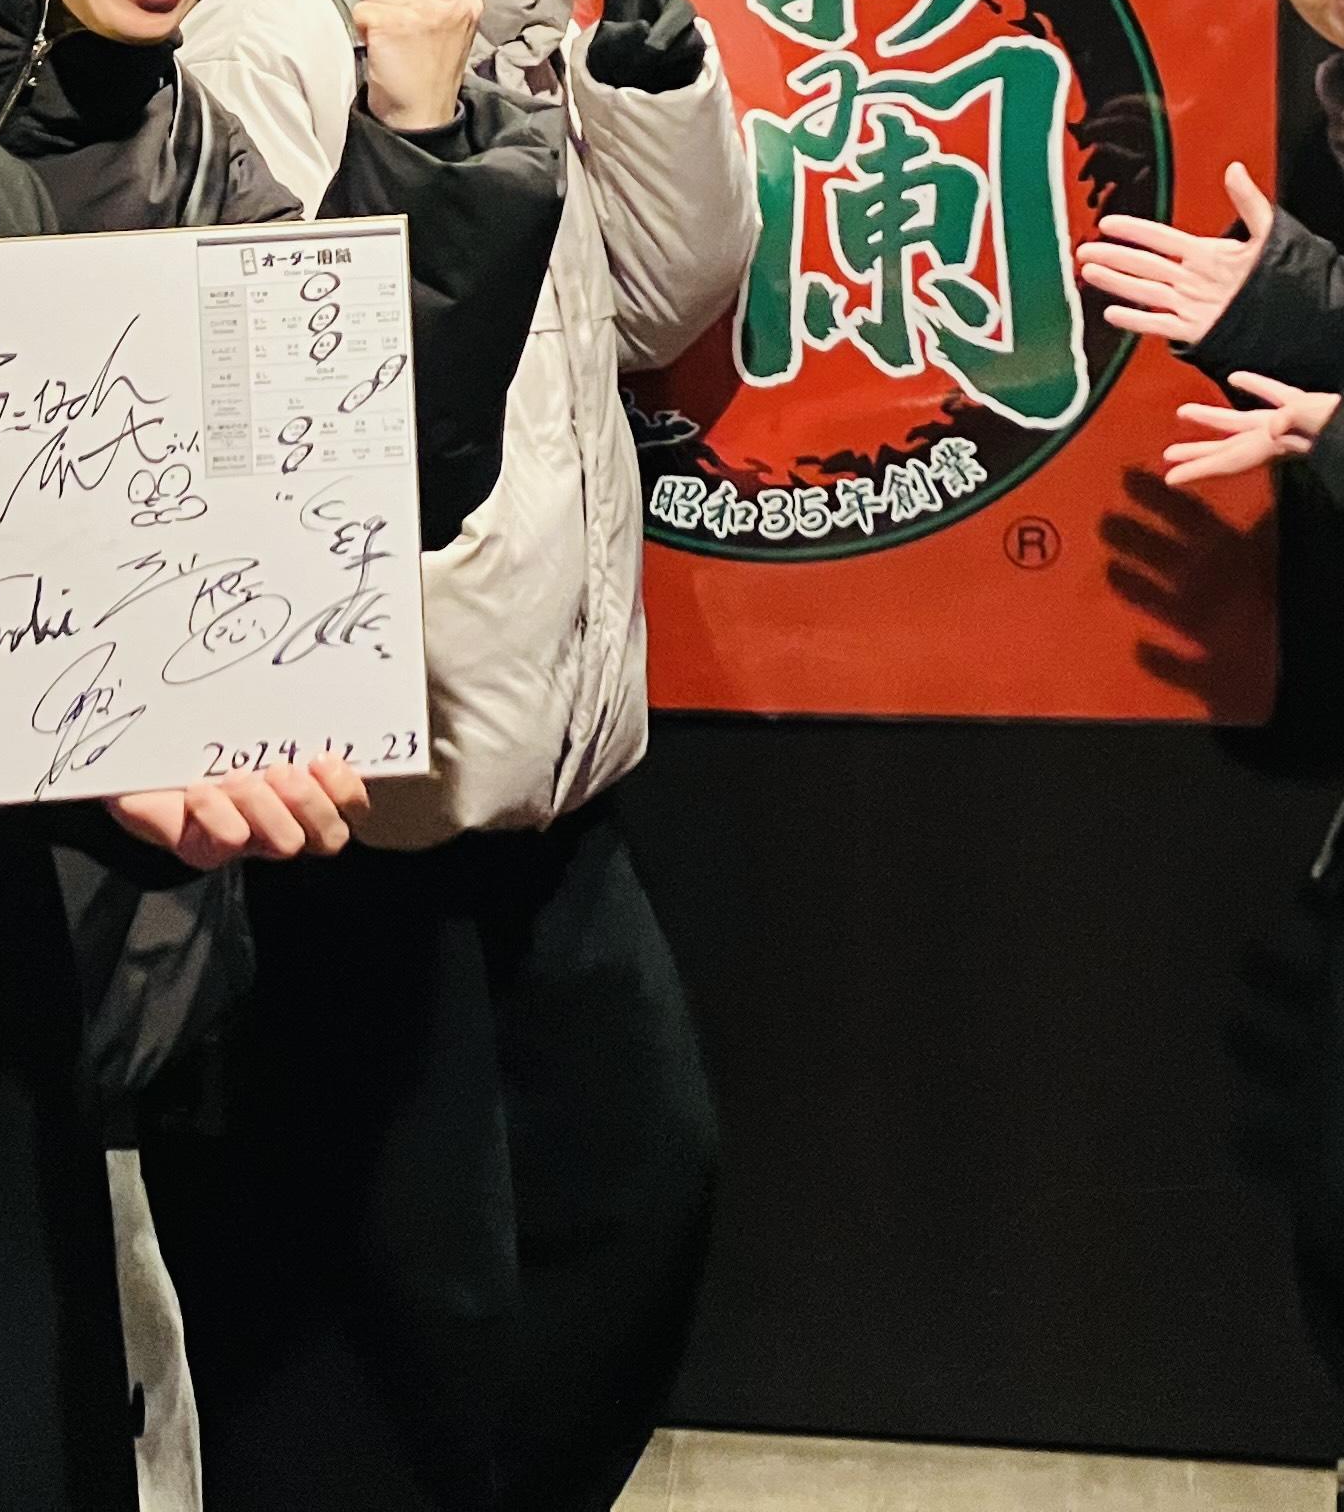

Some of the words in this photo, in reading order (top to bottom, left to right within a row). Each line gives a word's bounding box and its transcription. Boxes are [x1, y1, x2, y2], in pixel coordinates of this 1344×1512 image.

[649, 436, 988, 541] 昭和35年創業
